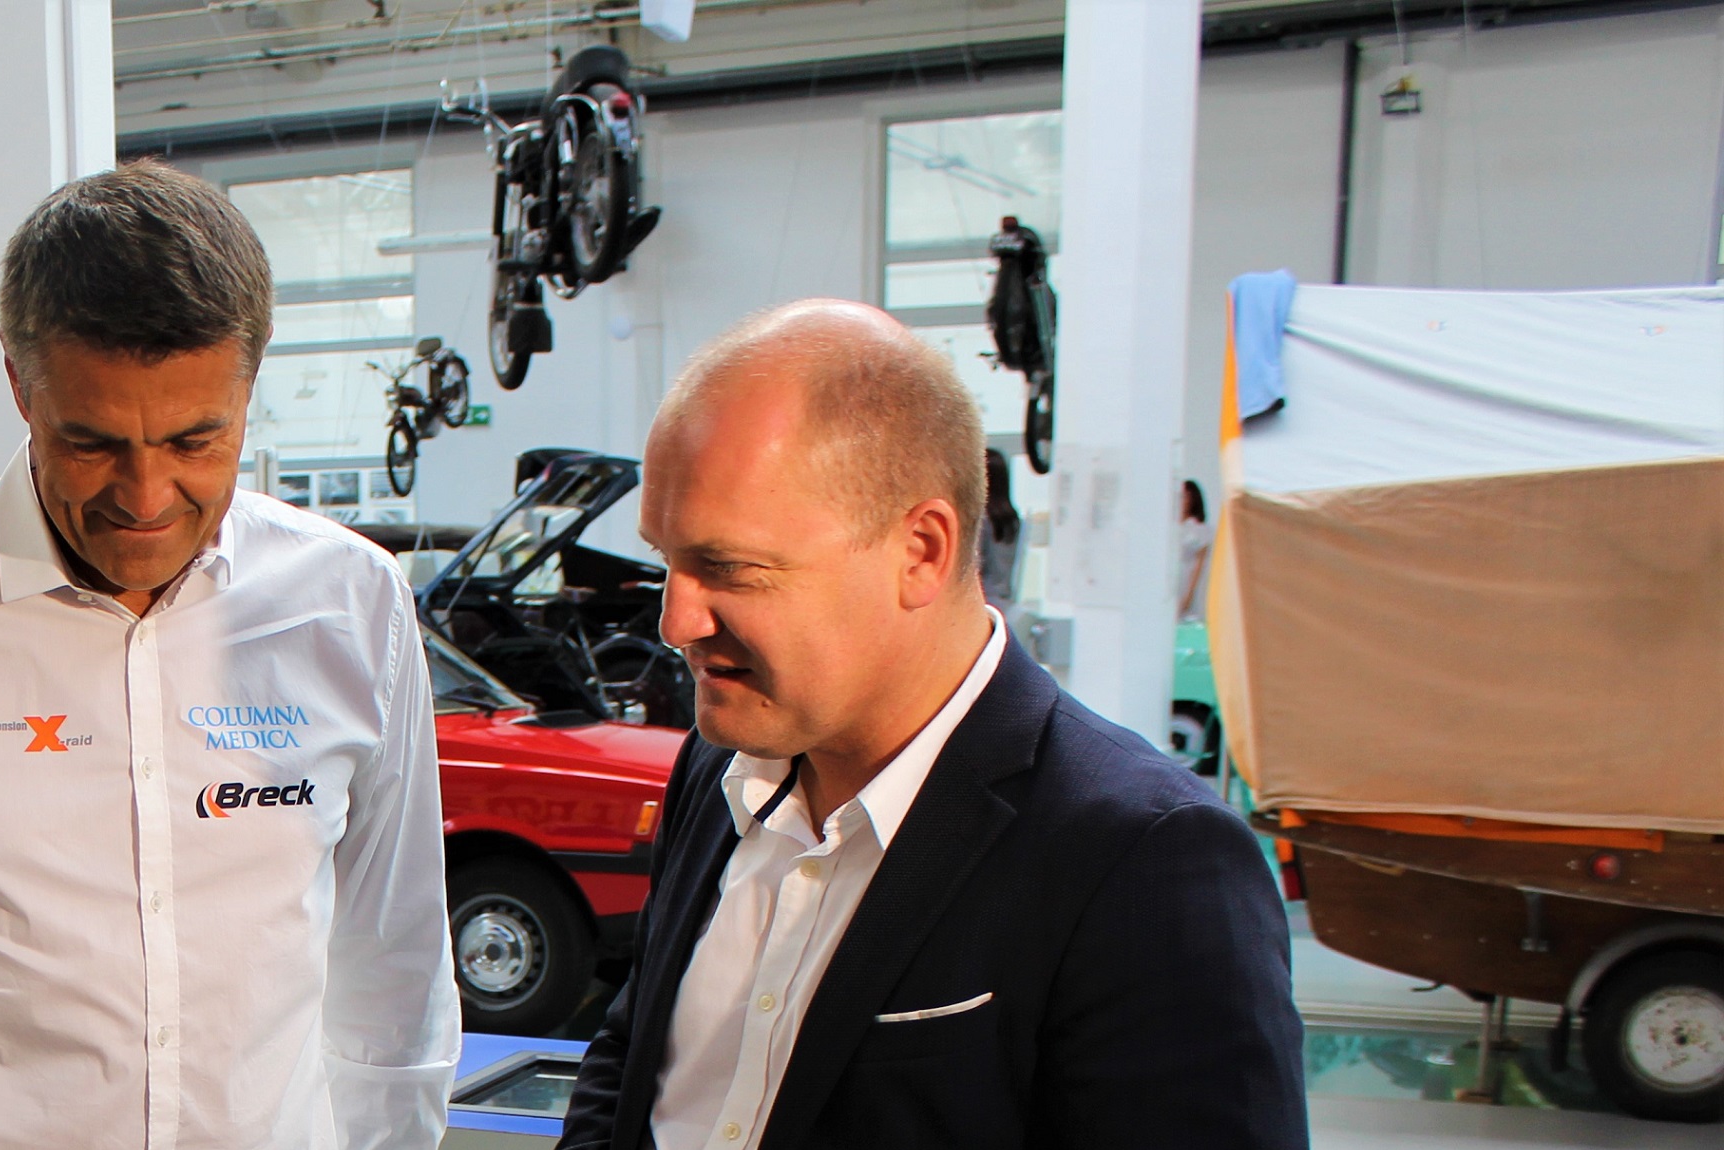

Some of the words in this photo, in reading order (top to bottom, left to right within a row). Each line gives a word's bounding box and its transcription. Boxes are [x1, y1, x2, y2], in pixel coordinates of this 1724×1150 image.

[188, 705, 310, 726] COLUMNA
[205, 730, 301, 750] MEDICA
[214, 778, 316, 809] Breck
